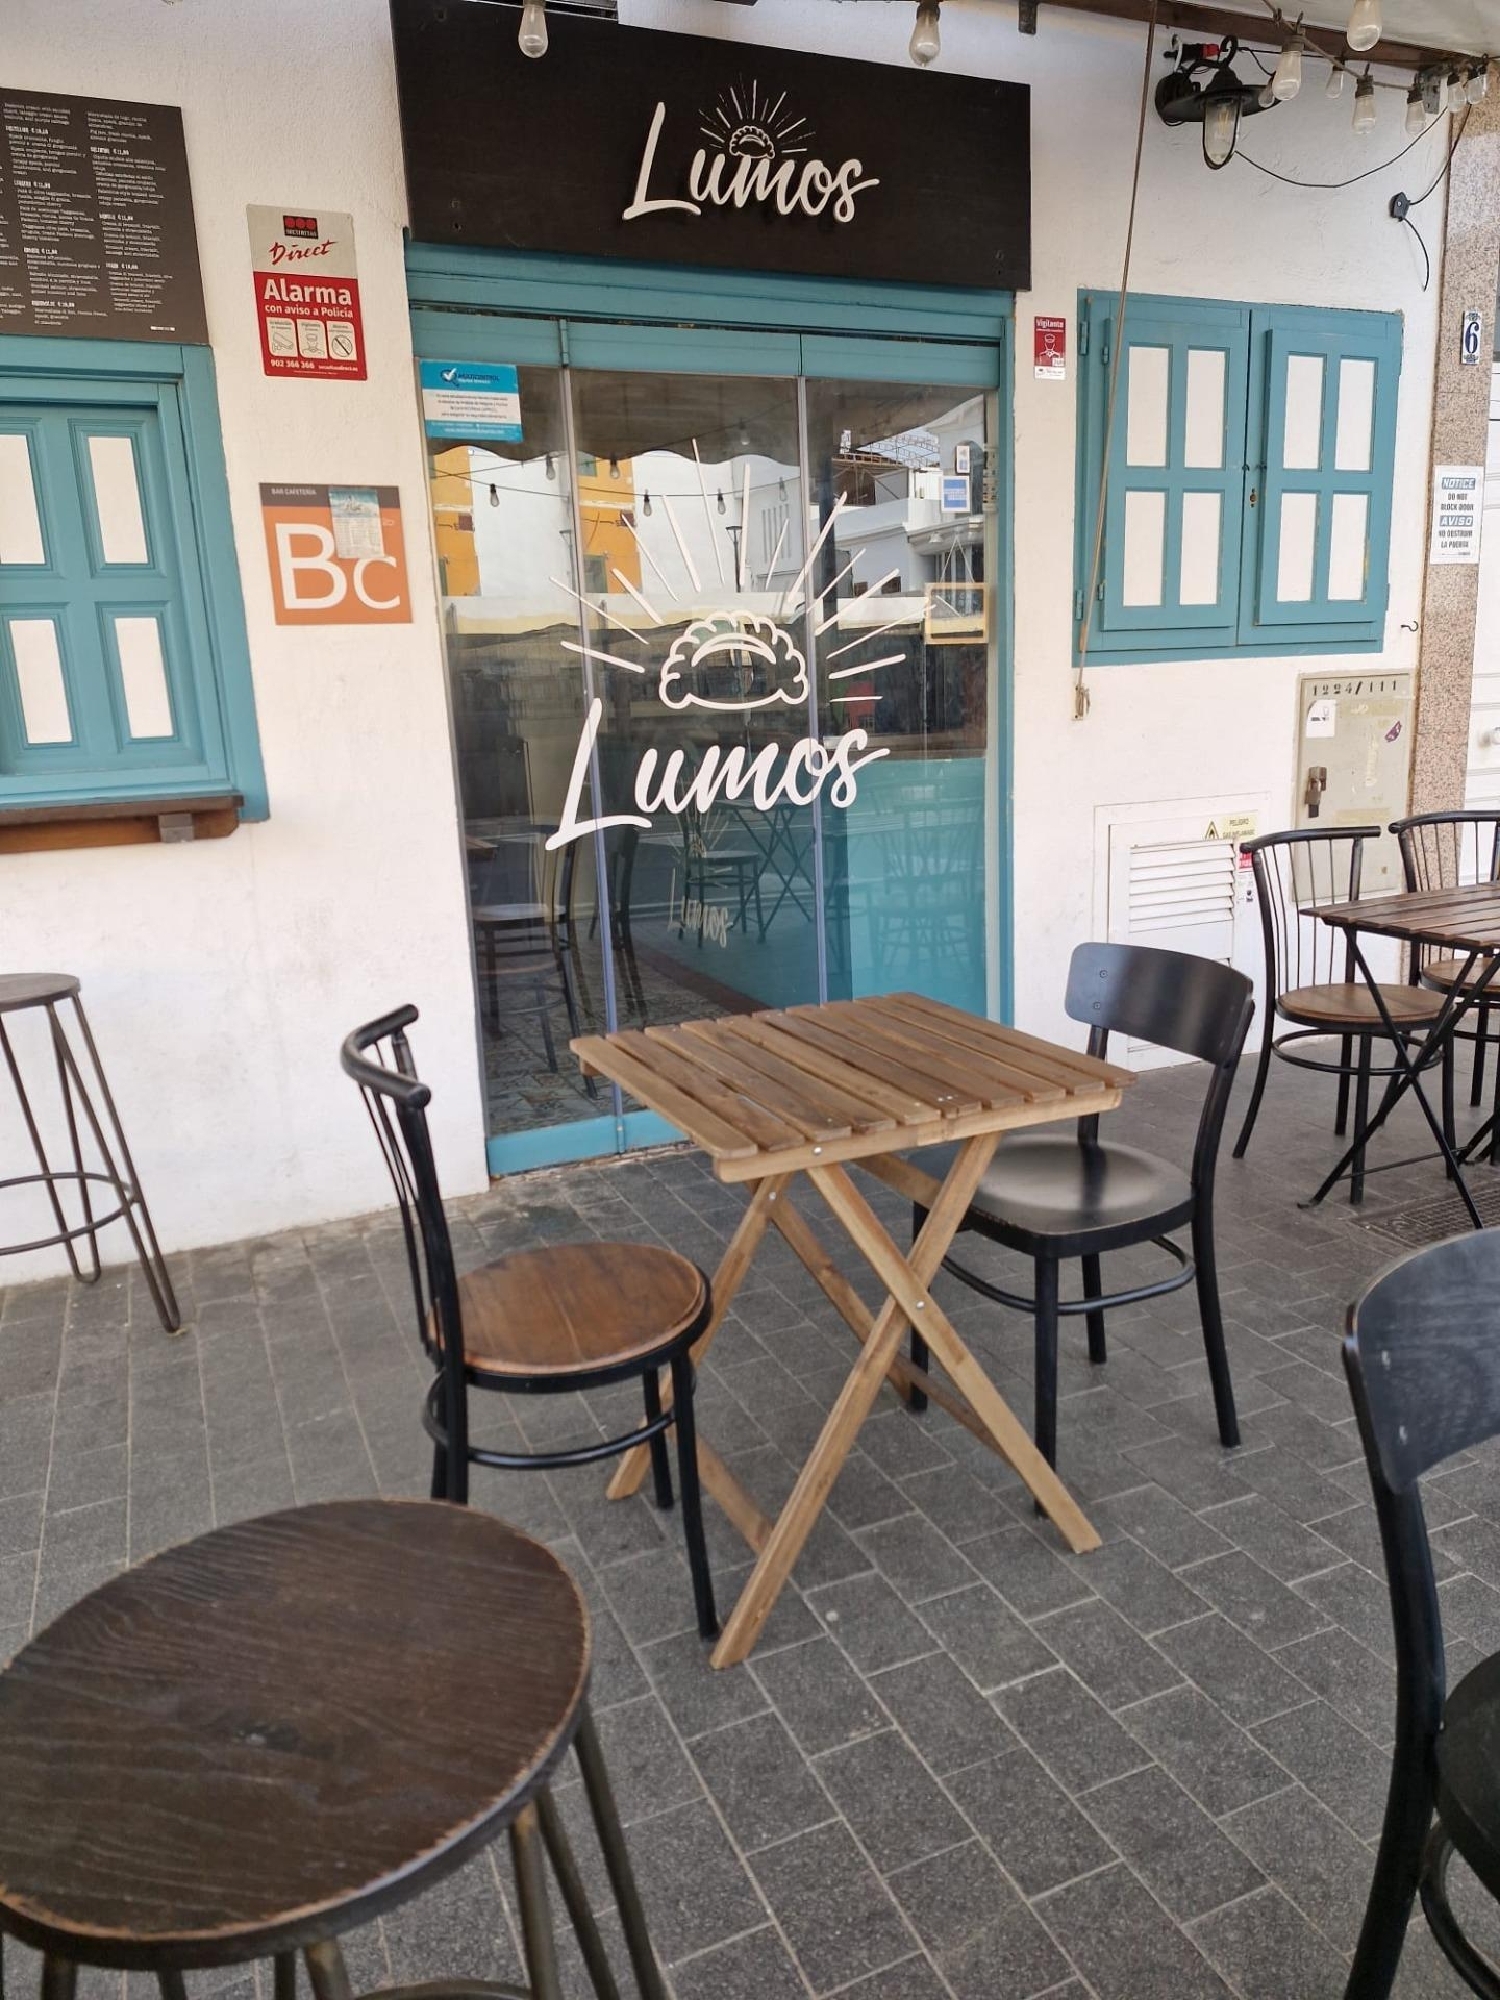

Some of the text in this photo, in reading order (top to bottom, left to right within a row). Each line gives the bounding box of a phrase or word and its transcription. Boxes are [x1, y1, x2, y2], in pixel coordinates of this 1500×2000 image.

[622, 101, 880, 223] Lumos
[269, 239, 339, 265] Direct
[263, 278, 352, 305] Alarma
[265, 304, 283, 314] con
[285, 303, 311, 316] aviso
[313, 307, 319, 316] a
[1465, 321, 1479, 354] 6
[270, 358, 284, 368] 902
[271, 487, 284, 496] BAR
[1442, 478, 1475, 490] NOTICE
[1440, 516, 1473, 526] AVISO
[545, 698, 890, 850] Lumos
